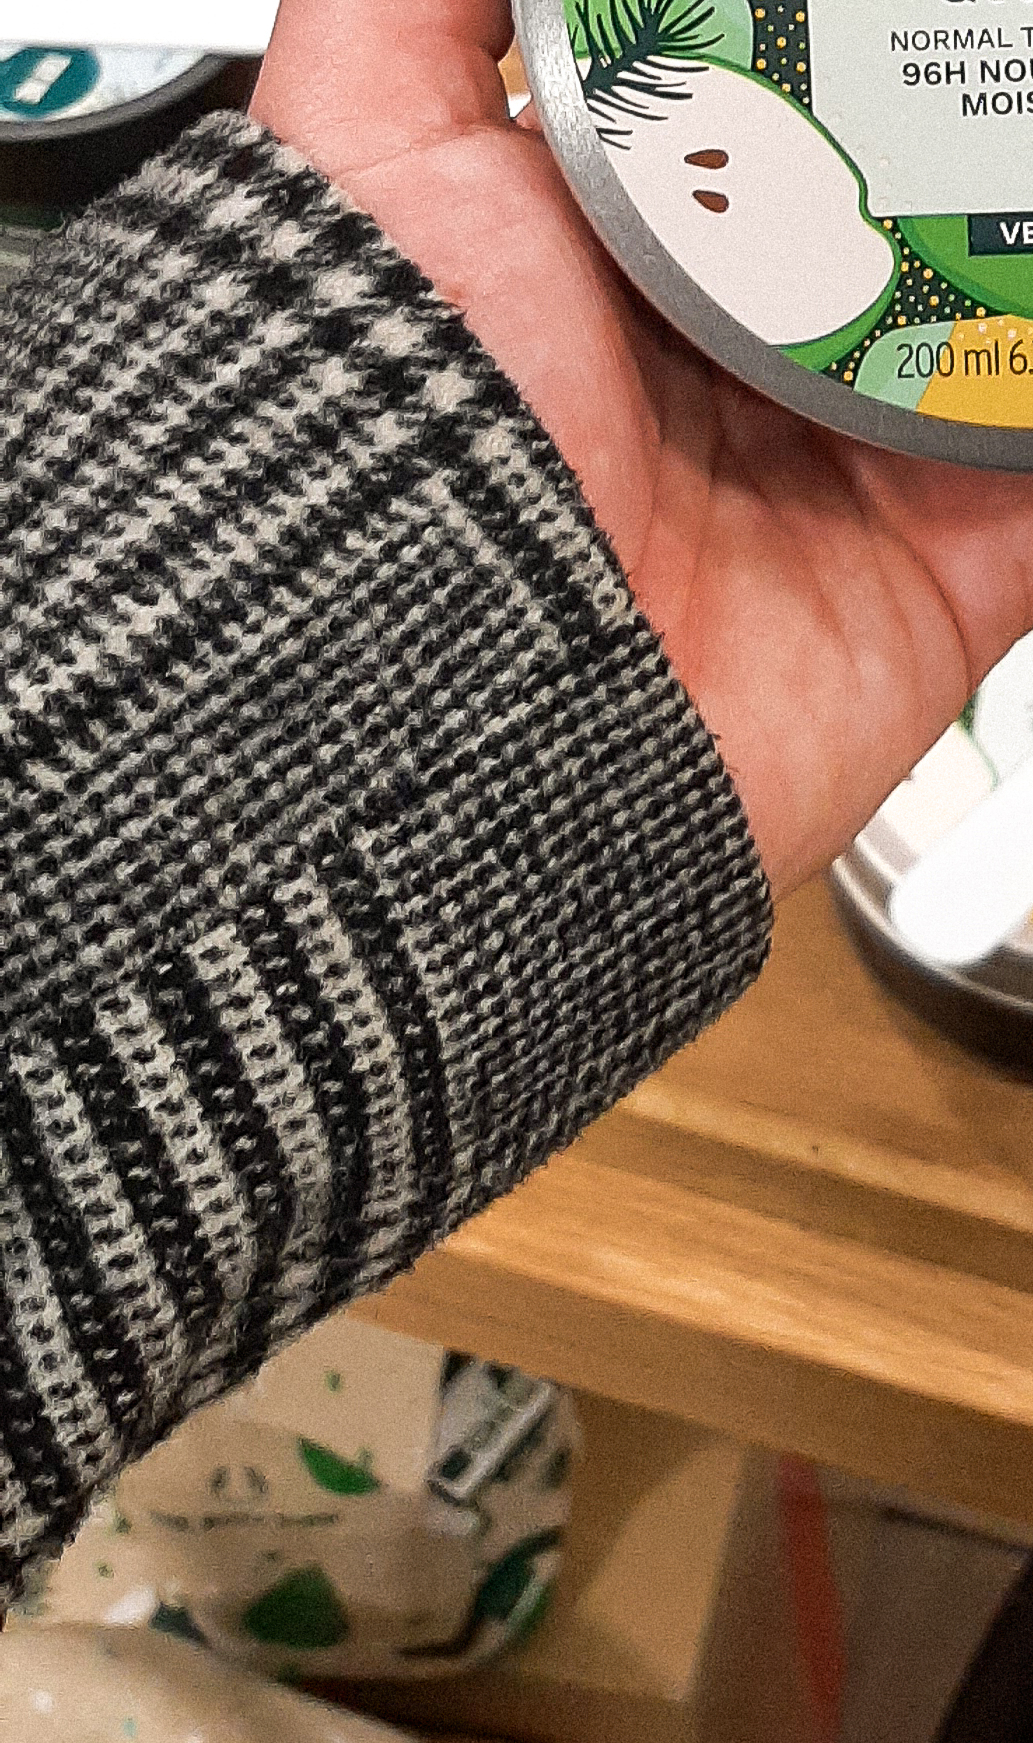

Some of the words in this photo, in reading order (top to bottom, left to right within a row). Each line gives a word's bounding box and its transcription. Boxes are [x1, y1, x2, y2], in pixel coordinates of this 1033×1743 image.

[890, 27, 1014, 52] NORMAL
[901, 60, 966, 87] 96H
[896, 341, 955, 380] 200
[963, 337, 1000, 377] ml
